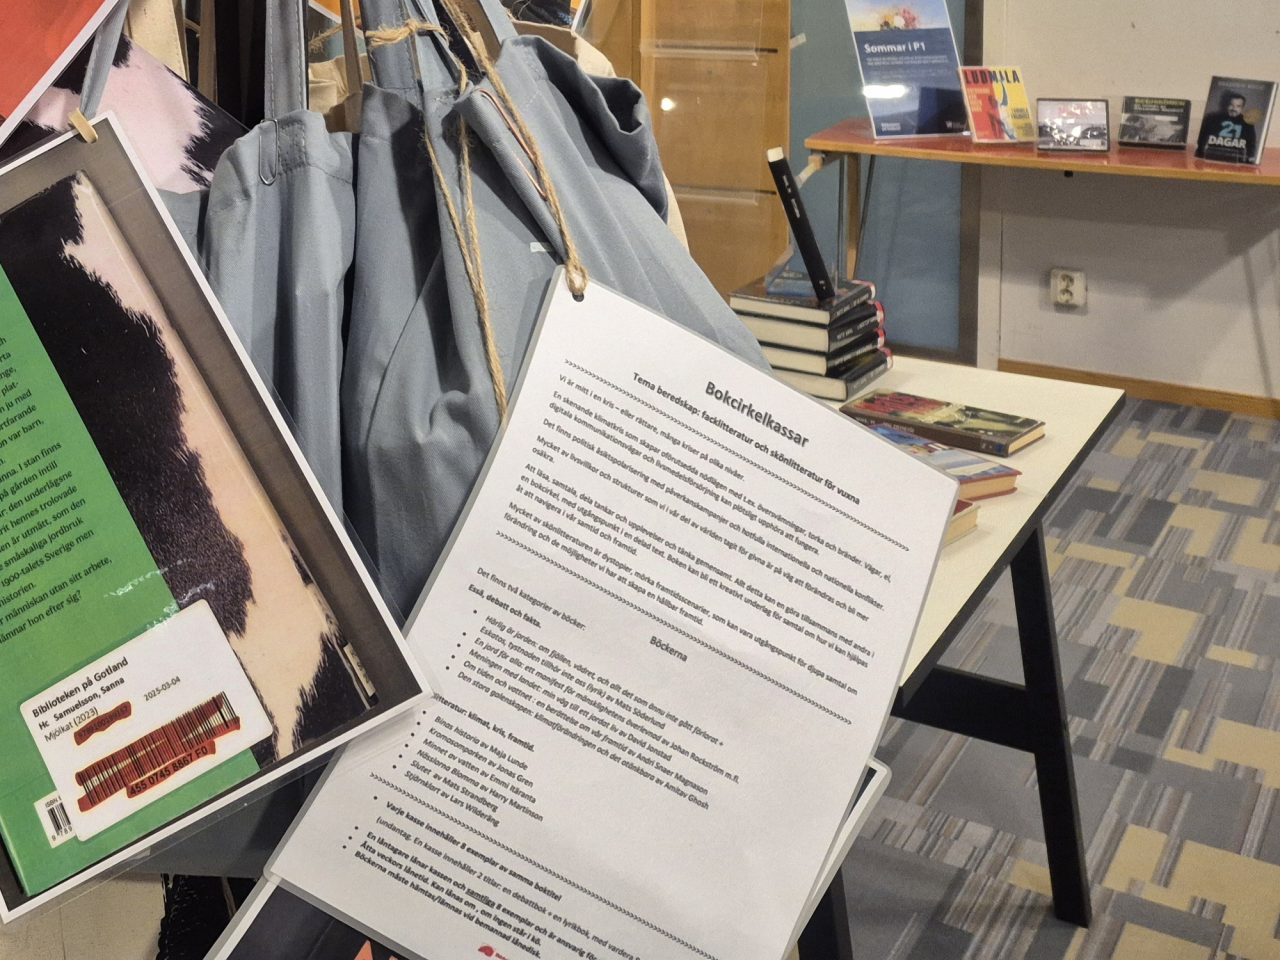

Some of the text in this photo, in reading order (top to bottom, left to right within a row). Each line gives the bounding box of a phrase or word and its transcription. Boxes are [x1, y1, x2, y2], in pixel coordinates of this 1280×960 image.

[864, 43, 906, 53] Sommar
[913, 42, 926, 51] P1
[964, 70, 1020, 83] LUDMILA
[1208, 135, 1247, 149] DAGAR
[1218, 121, 1242, 138] 21
[705, 381, 809, 447] Bokcirkelkassar
[633, 371, 860, 505] Tema beredskap: facklitteratur och skönlitteratur för vuxna
[26, 613, 45, 627] hon
[45, 600, 64, 617] efter
[65, 589, 81, 605] sig?
[649, 635, 688, 662] Böckerna
[31, 656, 128, 718] Biblioteken på Gotland
[53, 692, 101, 722] Samuelsson,
[100, 677, 125, 695] Sanna
[143, 675, 181, 701] 2025-03-04
[72, 706, 99, 727] (2023)
